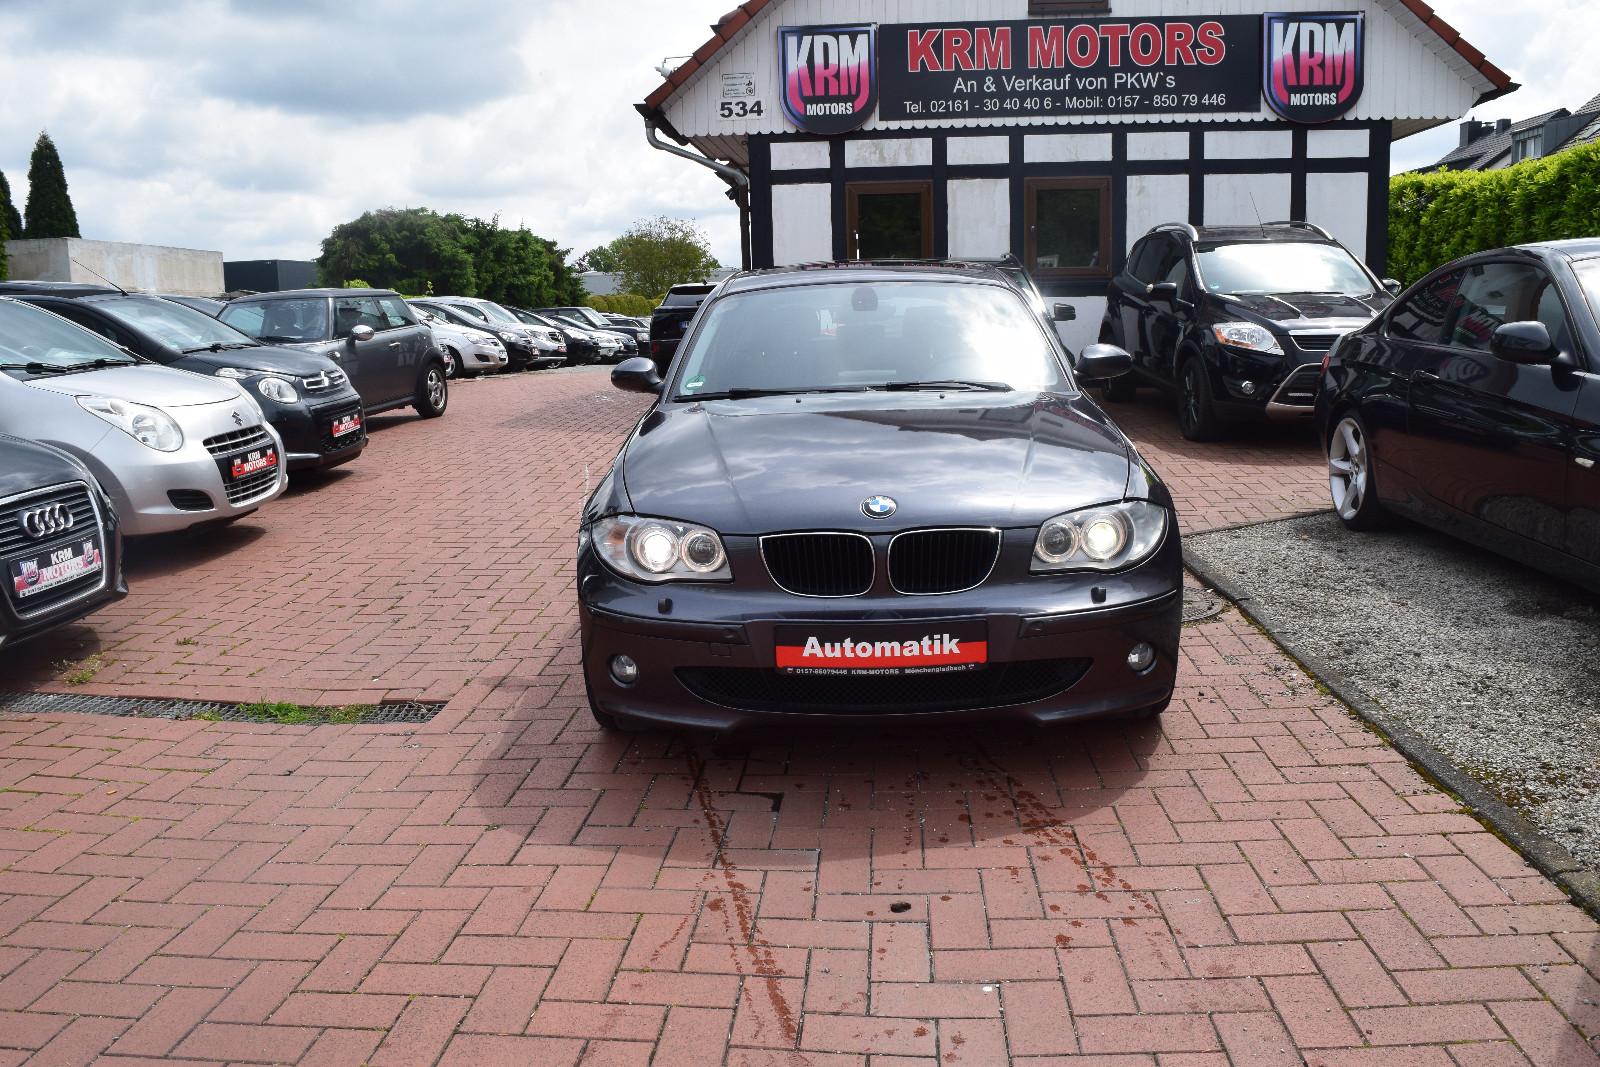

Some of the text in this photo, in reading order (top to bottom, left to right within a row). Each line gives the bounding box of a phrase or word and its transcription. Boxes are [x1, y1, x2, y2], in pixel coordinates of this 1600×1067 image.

[907, 21, 1226, 72] KRM MOTORS
[1273, 22, 1355, 86] KRM
[787, 33, 869, 97] KRM
[953, 77, 977, 93] An
[983, 76, 997, 92] &
[1001, 74, 1071, 92] Verkauf
[1075, 77, 1107, 90] von
[720, 100, 764, 118] 534
[806, 102, 853, 116] MOTORS
[904, 101, 926, 113] Tel.
[930, 100, 969, 112] 02161
[983, 98, 1000, 111] 30
[1003, 98, 1020, 110] 40
[1023, 97, 1040, 110] 40
[1043, 97, 1052, 110] 6
[1065, 95, 1103, 109] Mobil:
[1107, 95, 1140, 108] 0157
[1153, 94, 1178, 107] 850
[1181, 94, 1198, 106] 79
[1201, 93, 1226, 106] 446
[1290, 93, 1337, 106] MOTORS
[244, 457, 267, 472] MOTORS
[50, 547, 74, 565] KRM
[41, 555, 84, 581] MOTORS
[802, 633, 961, 658] Automatik
[904, 664, 966, 674] Mönchengladbach
